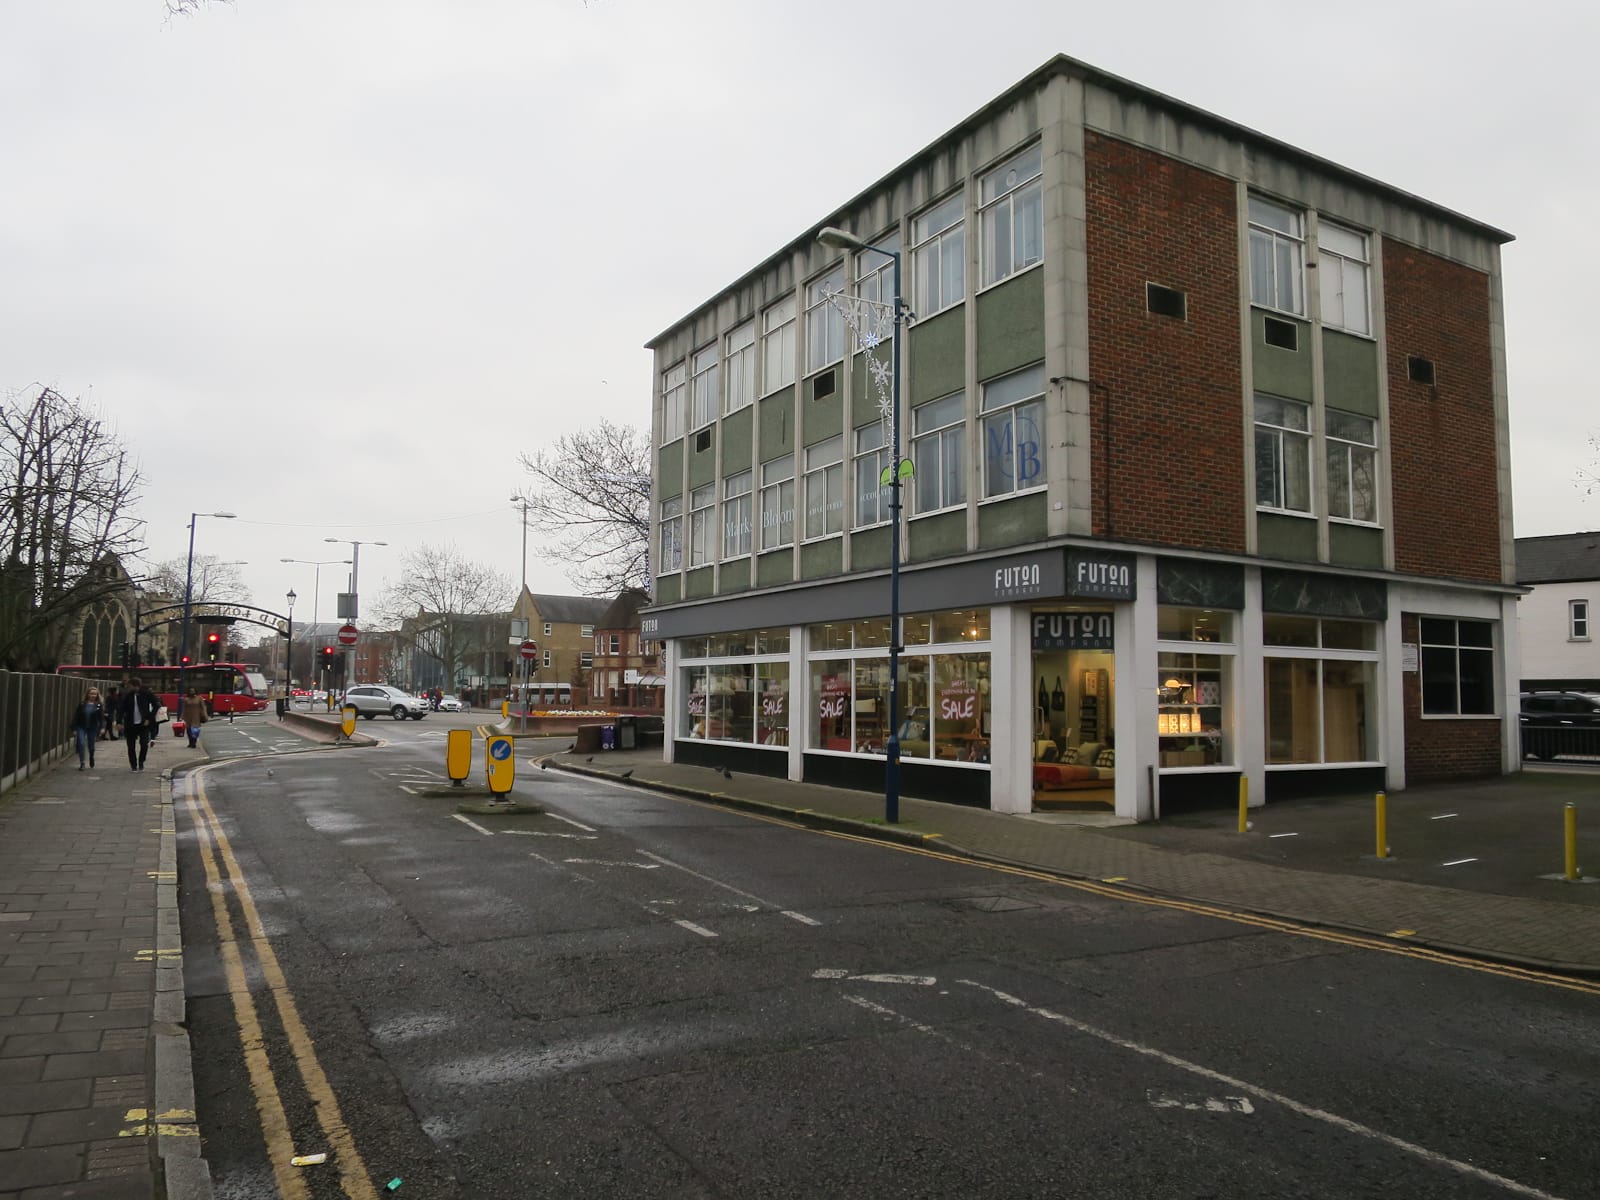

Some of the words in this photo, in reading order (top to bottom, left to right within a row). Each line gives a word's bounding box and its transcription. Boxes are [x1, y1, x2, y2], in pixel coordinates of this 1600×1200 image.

[726, 516, 752, 538] Marks
[763, 508, 796, 528] Bloom
[995, 564, 1040, 589] FUTON
[1077, 562, 1129, 586] FUTON
[1033, 615, 1111, 638] FUTON
[687, 698, 704, 715] SALE
[762, 697, 784, 716] SALE
[819, 697, 844, 718] SALE
[941, 696, 975, 721] SALE
